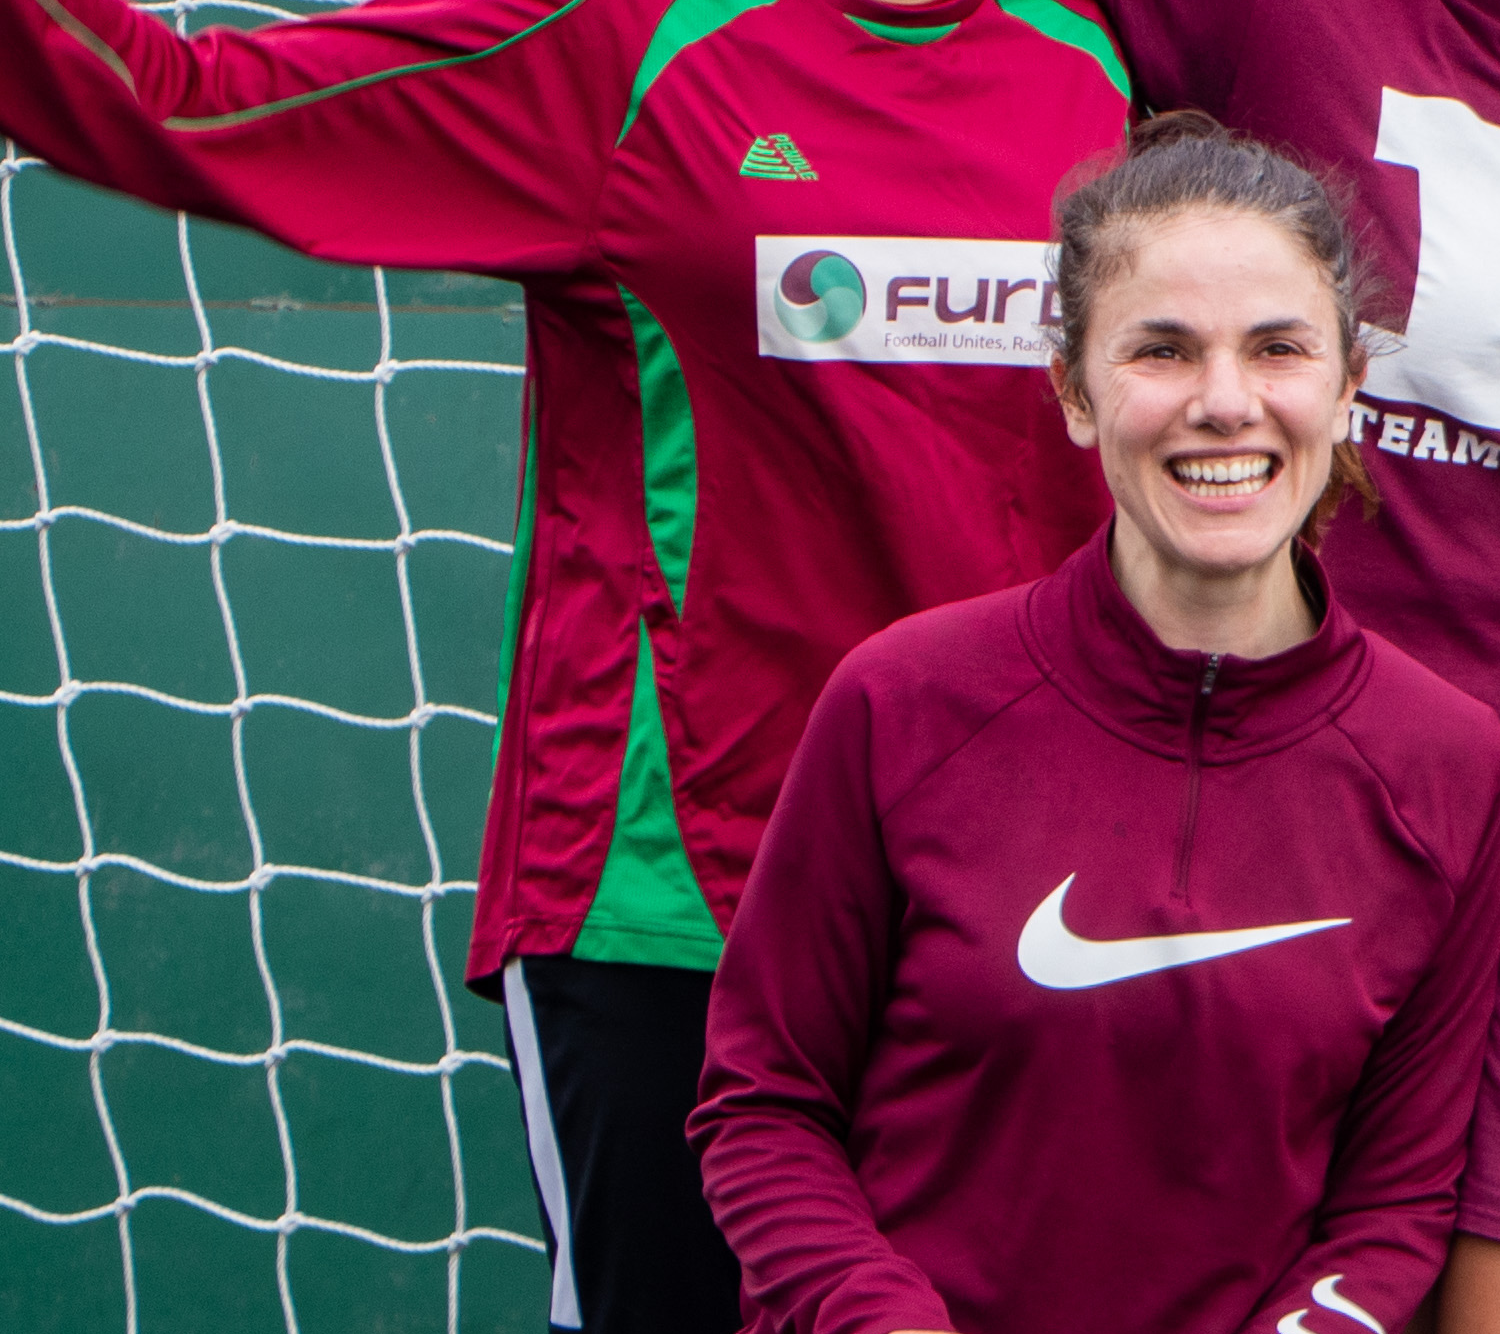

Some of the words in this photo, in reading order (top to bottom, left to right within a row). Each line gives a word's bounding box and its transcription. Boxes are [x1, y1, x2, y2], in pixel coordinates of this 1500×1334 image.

[884, 332, 947, 349] Football
[952, 334, 1007, 351] Unites,
[1012, 336, 1056, 352] Racis
